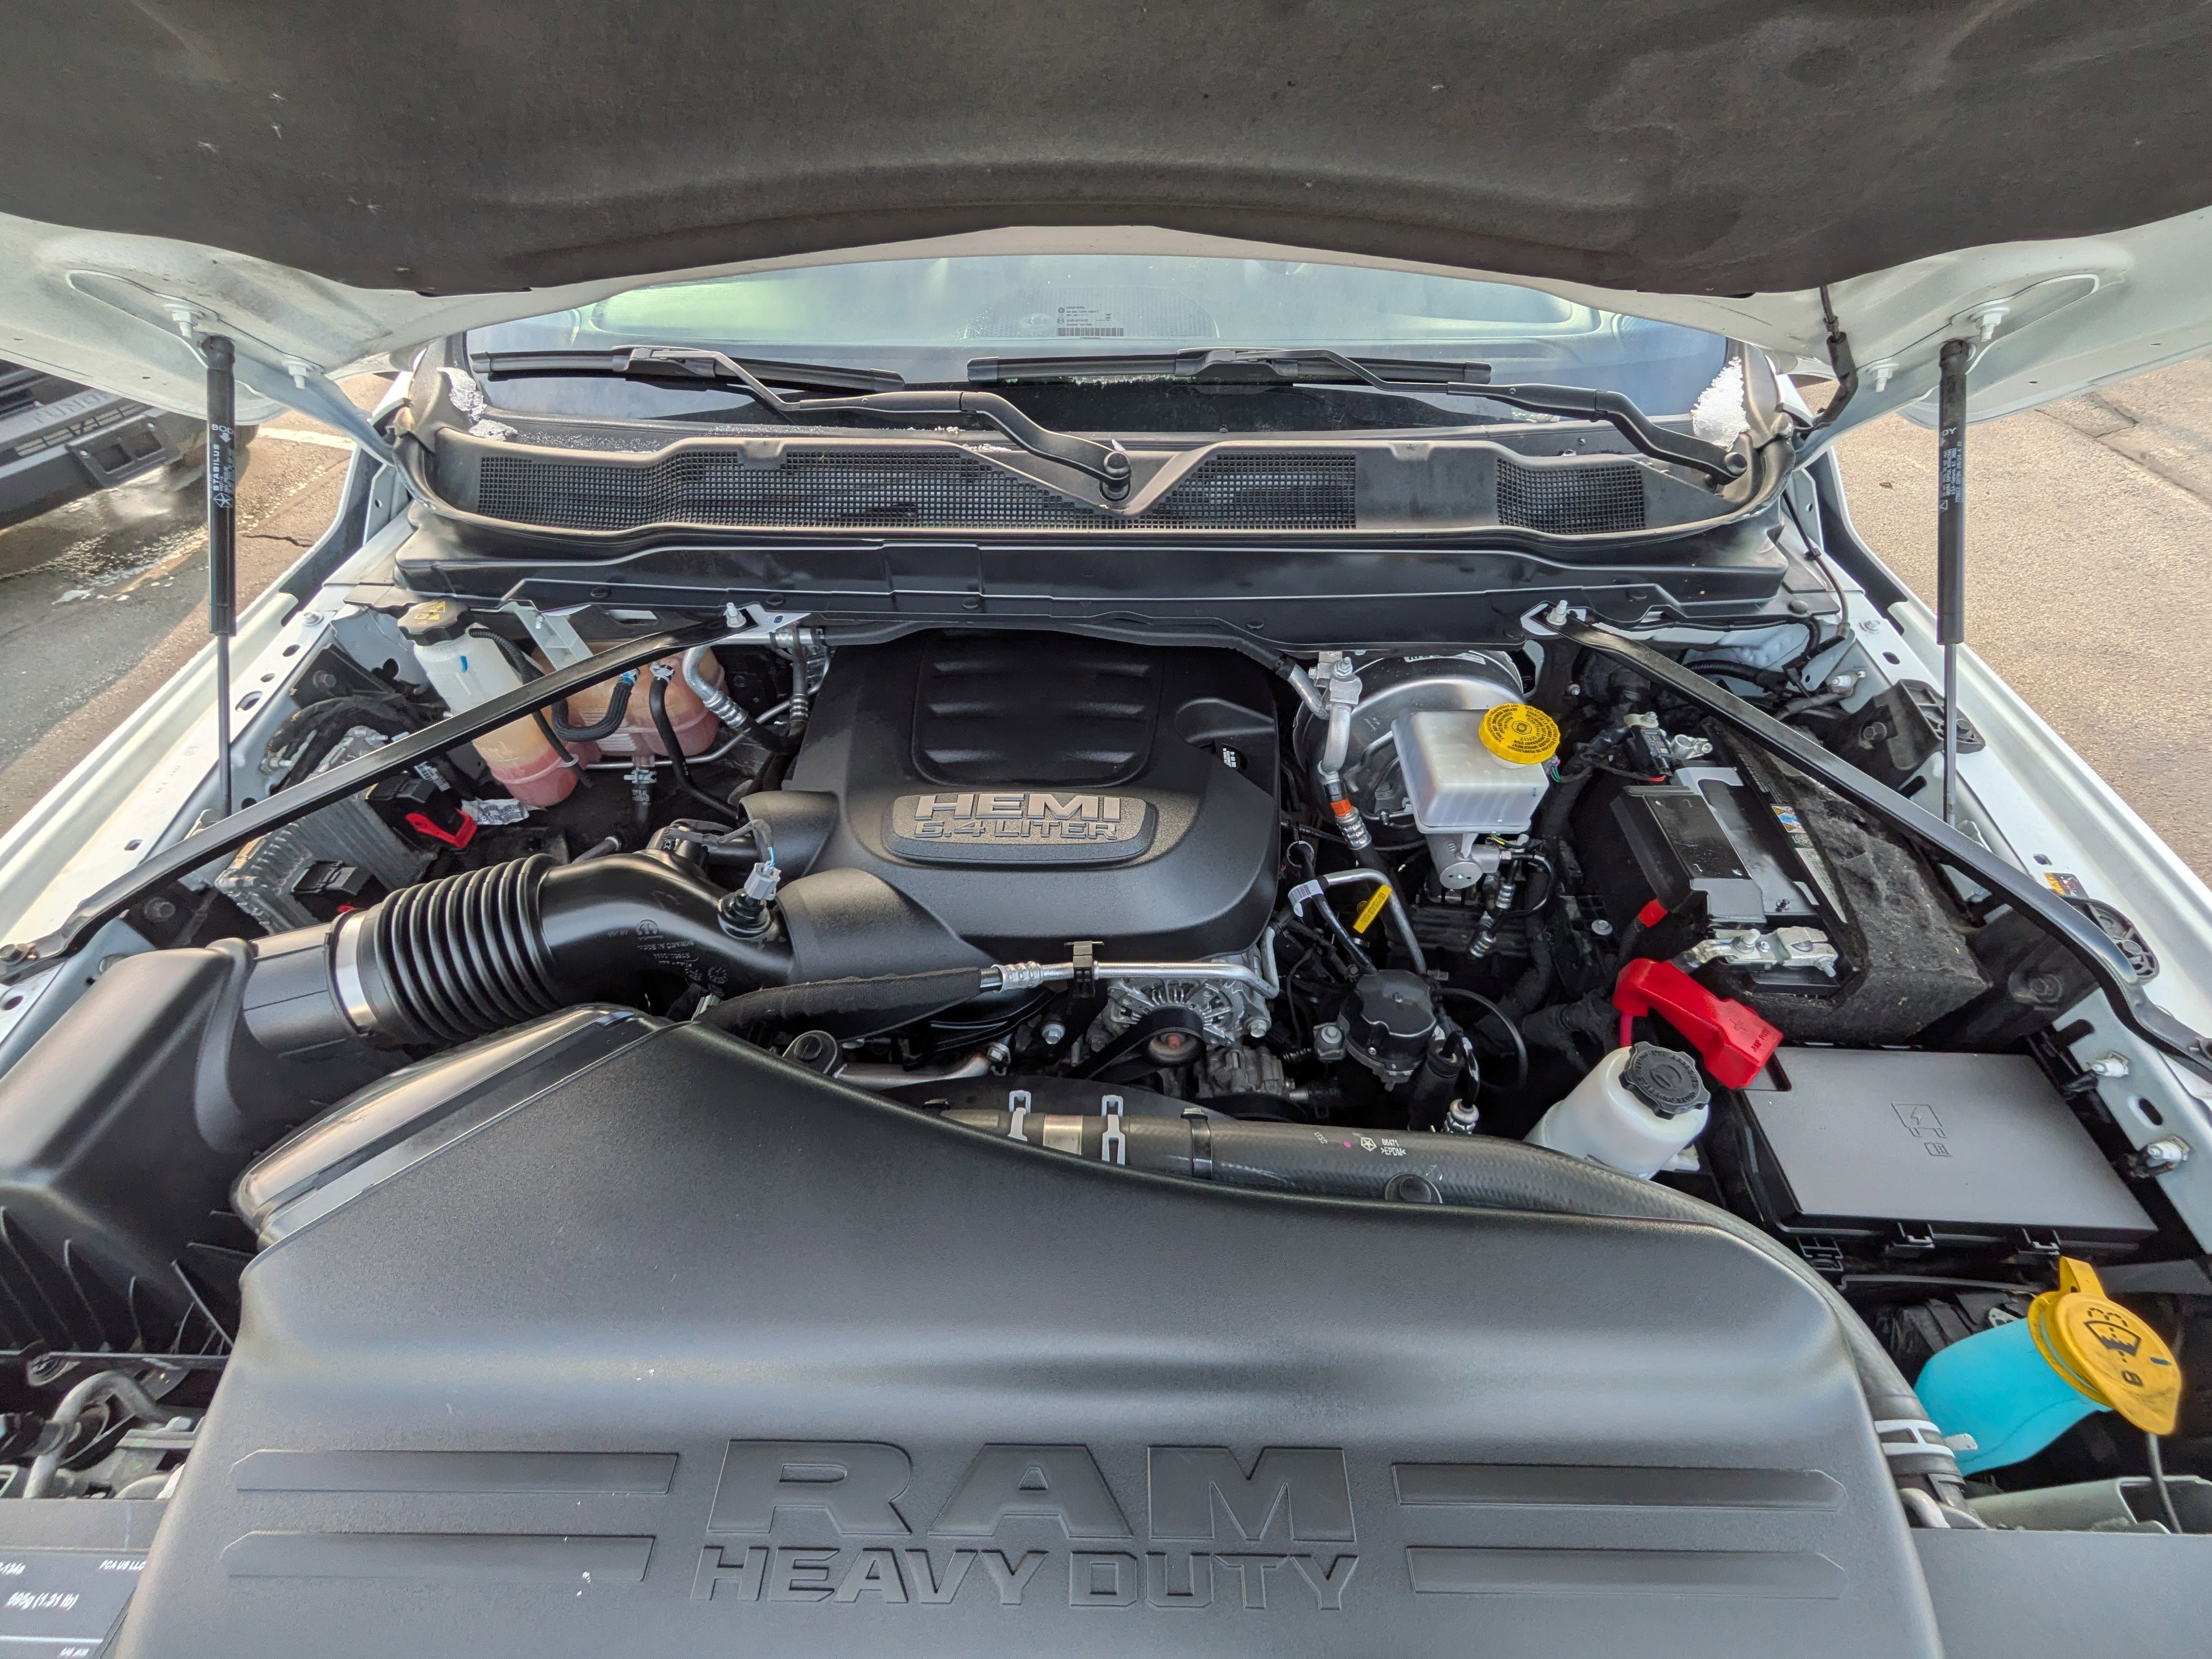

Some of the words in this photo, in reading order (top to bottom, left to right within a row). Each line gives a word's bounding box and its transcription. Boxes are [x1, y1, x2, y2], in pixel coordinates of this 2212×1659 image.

[211, 424, 234, 435] BOD
[1943, 427, 1957, 436] DY
[914, 793, 1121, 822] HEMI
[914, 821, 986, 838] 6.4
[994, 820, 1118, 840] LITER
[706, 1438, 1357, 1542] RAM
[0, 1562, 26, 1575] -134a
[691, 1546, 1050, 1605] HEAVY
[1070, 1551, 1359, 1610] DUTY
